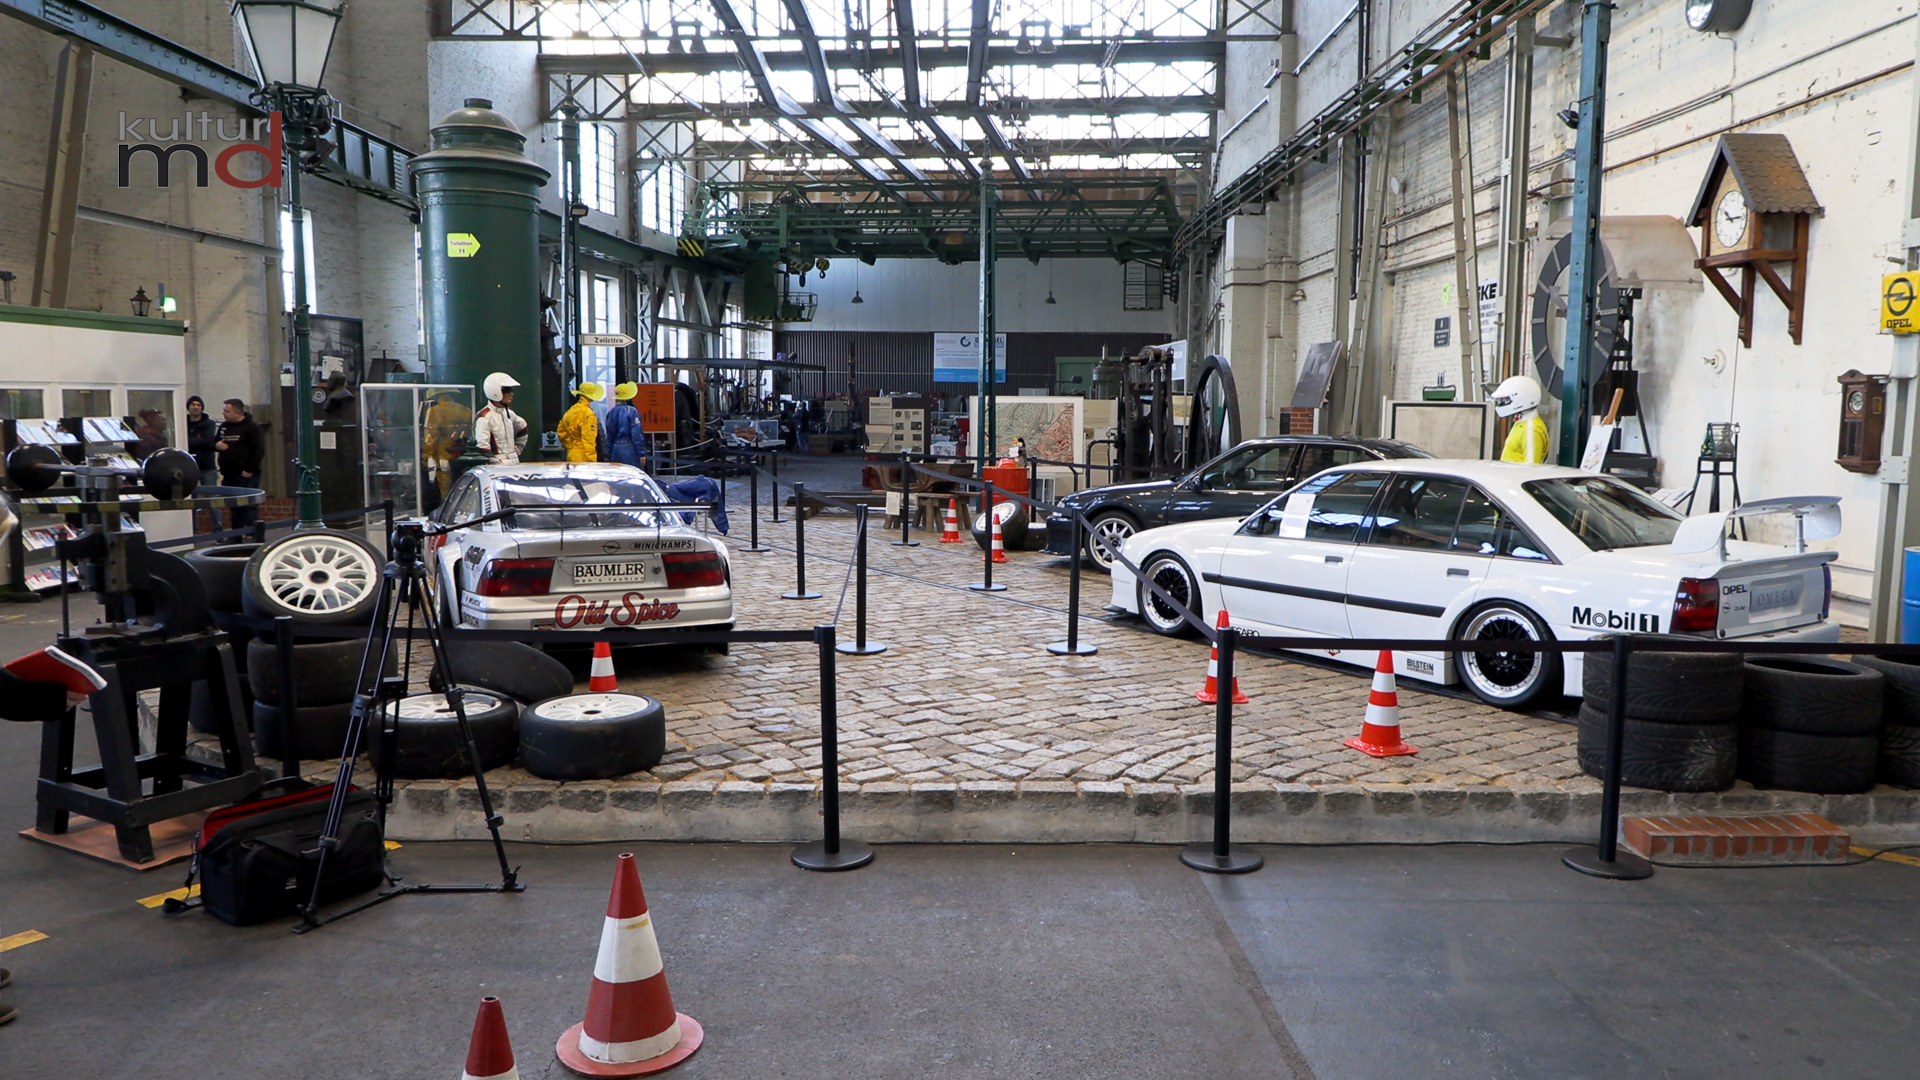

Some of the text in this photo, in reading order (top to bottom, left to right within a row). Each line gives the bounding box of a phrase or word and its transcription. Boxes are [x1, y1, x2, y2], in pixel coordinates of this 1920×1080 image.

[1886, 318, 1912, 328] OPEL
[633, 540, 692, 550] MINICHAMPS
[574, 563, 645, 578] BÄUMLER
[1722, 584, 1748, 596] OPEL
[1757, 589, 1795, 606] OMEGA
[555, 592, 681, 628] Old Spice
[1572, 606, 1636, 631] Mobil
[1406, 658, 1434, 671] BILSTEIN
